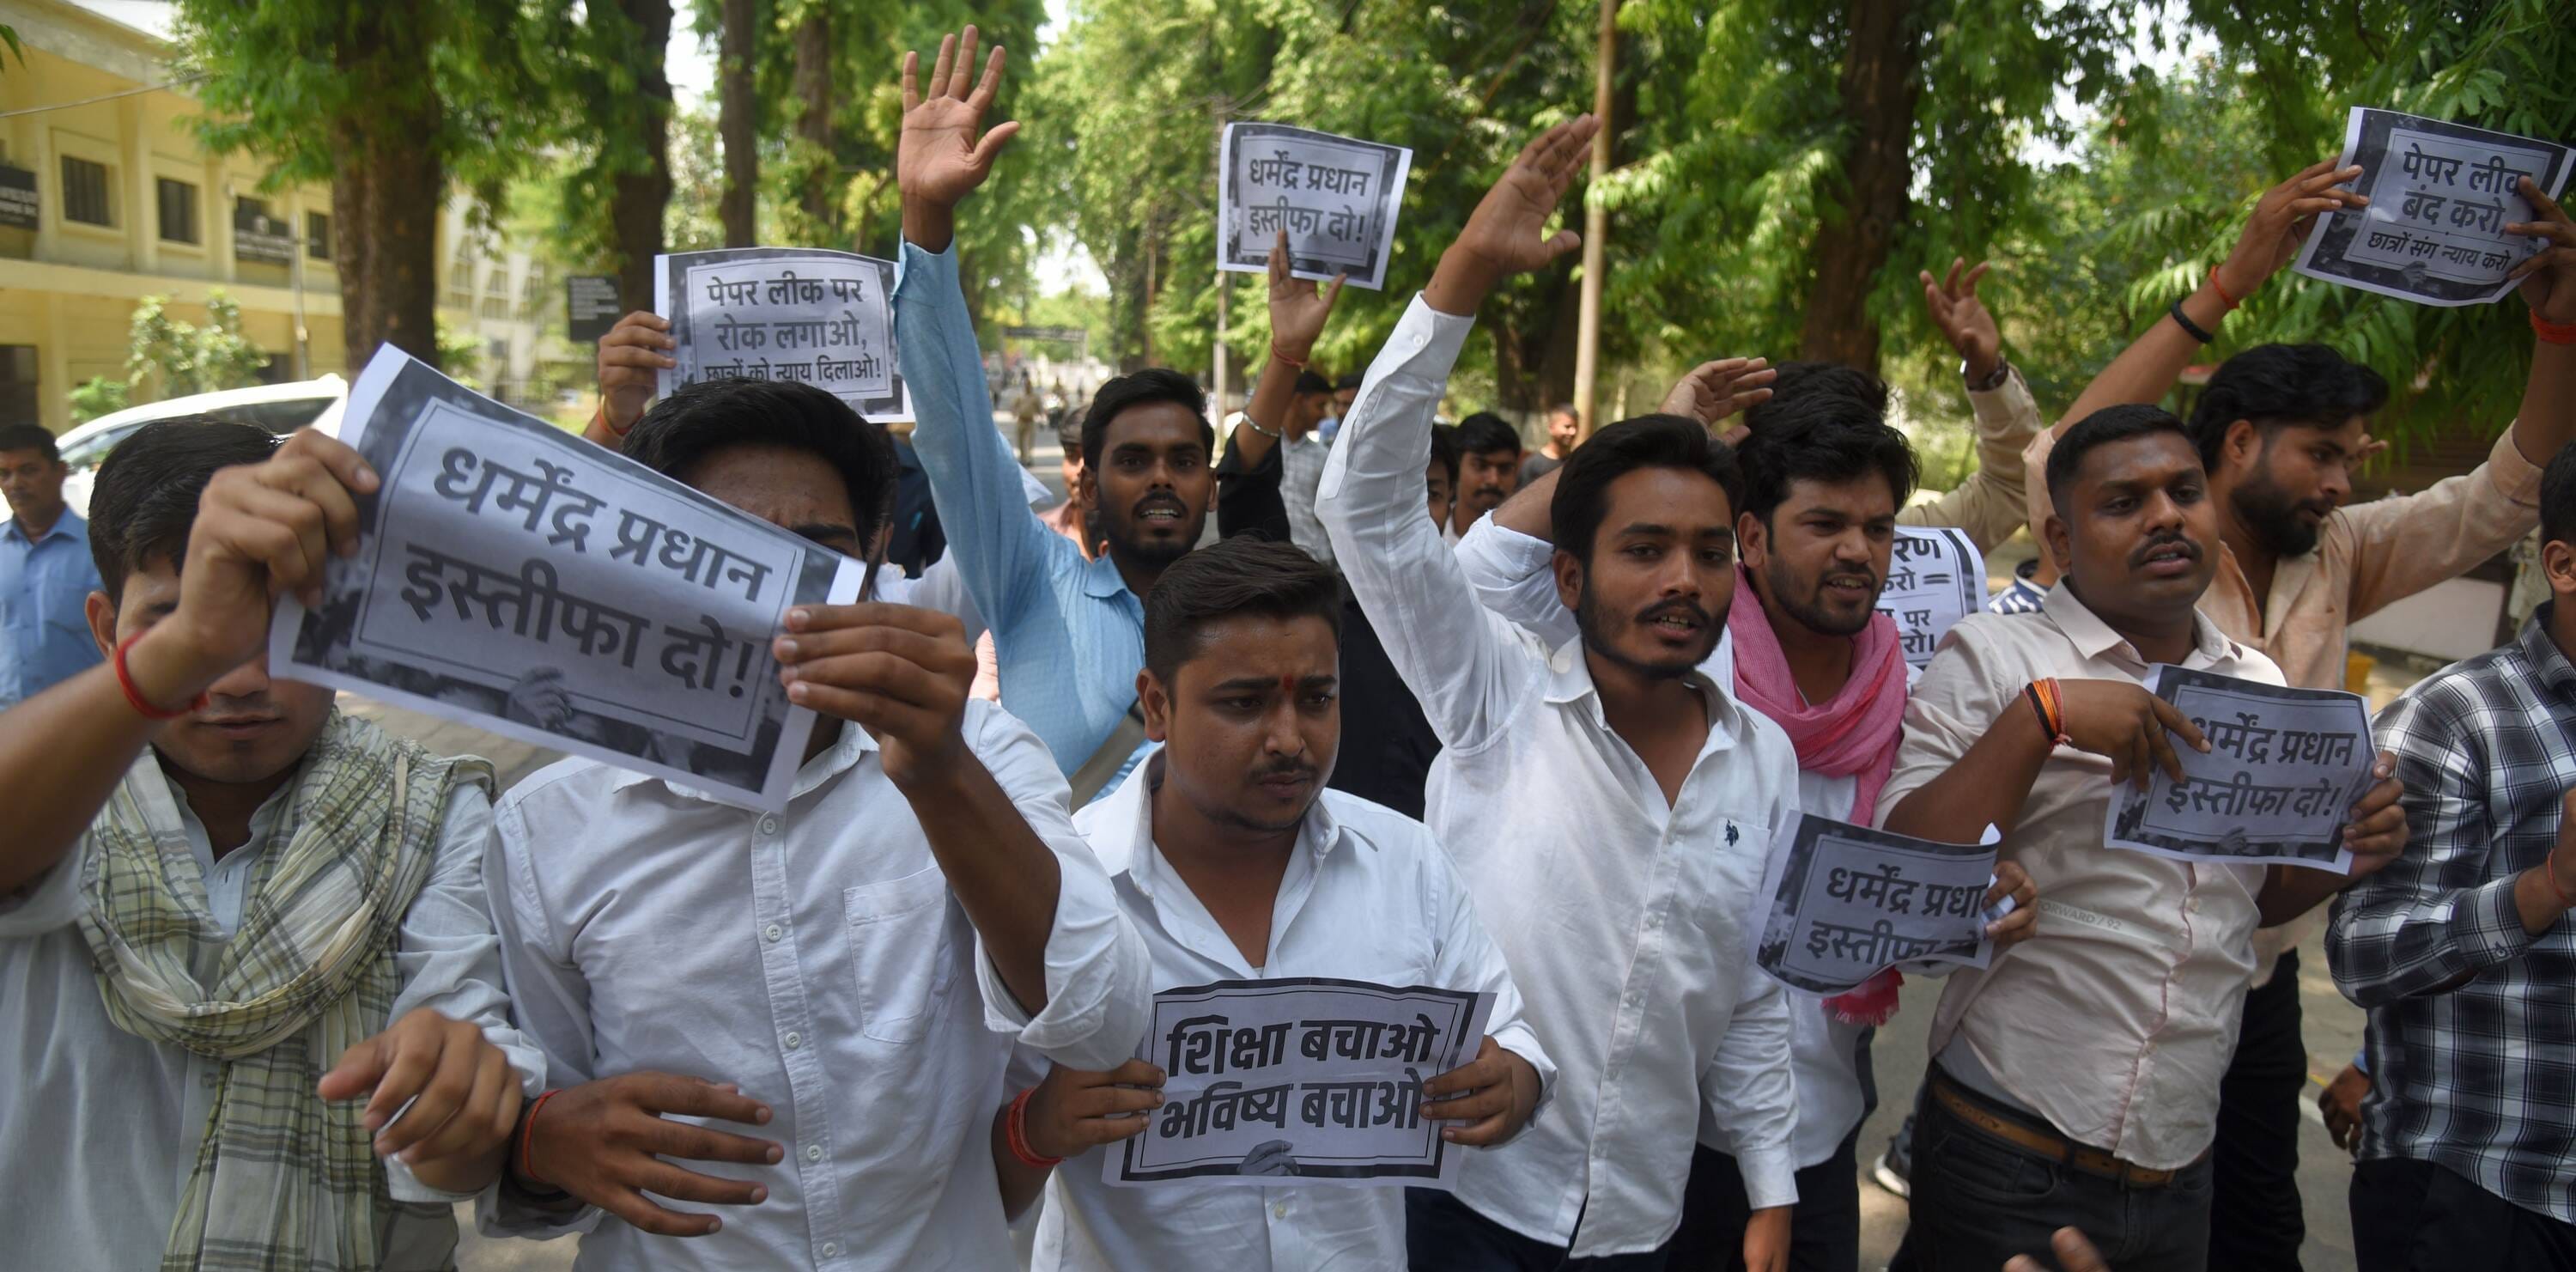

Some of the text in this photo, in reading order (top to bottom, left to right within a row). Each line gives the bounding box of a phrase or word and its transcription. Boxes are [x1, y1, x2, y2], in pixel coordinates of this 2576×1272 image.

[1249, 150, 1371, 197] धर्मेंद्र प्रधान
[2403, 143, 2463, 186] पेपर
[1249, 196, 1366, 242] इस्तीफा दो!
[2402, 185, 2446, 225] बंद
[2367, 231, 2512, 272] छात्रों संग न्याय करो
[707, 271, 864, 306] पेपर लीक पर
[714, 310, 866, 350] रोक लगाओ,
[748, 357, 770, 380] को
[775, 362, 812, 381] न्याय
[817, 353, 881, 381] दिलाओ!
[433, 447, 774, 603] धर्मेंद्र प्रधान
[1893, 537, 1941, 563] रण
[400, 543, 756, 699] इस्तीफा दो!
[1903, 610, 1931, 627] पर
[2277, 731, 2357, 766] प्रधान
[2166, 770, 2342, 818] इस्तीफा दो!
[1826, 864, 1990, 918] धर्मेंद्र प्रधा
[2039, 901, 2096, 924] ORWARD
[2106, 919, 2123, 930] 92
[1167, 1013, 1441, 1078] शिक्षा बचाओ
[1159, 1068, 1425, 1139] भविष्य बचाओ
